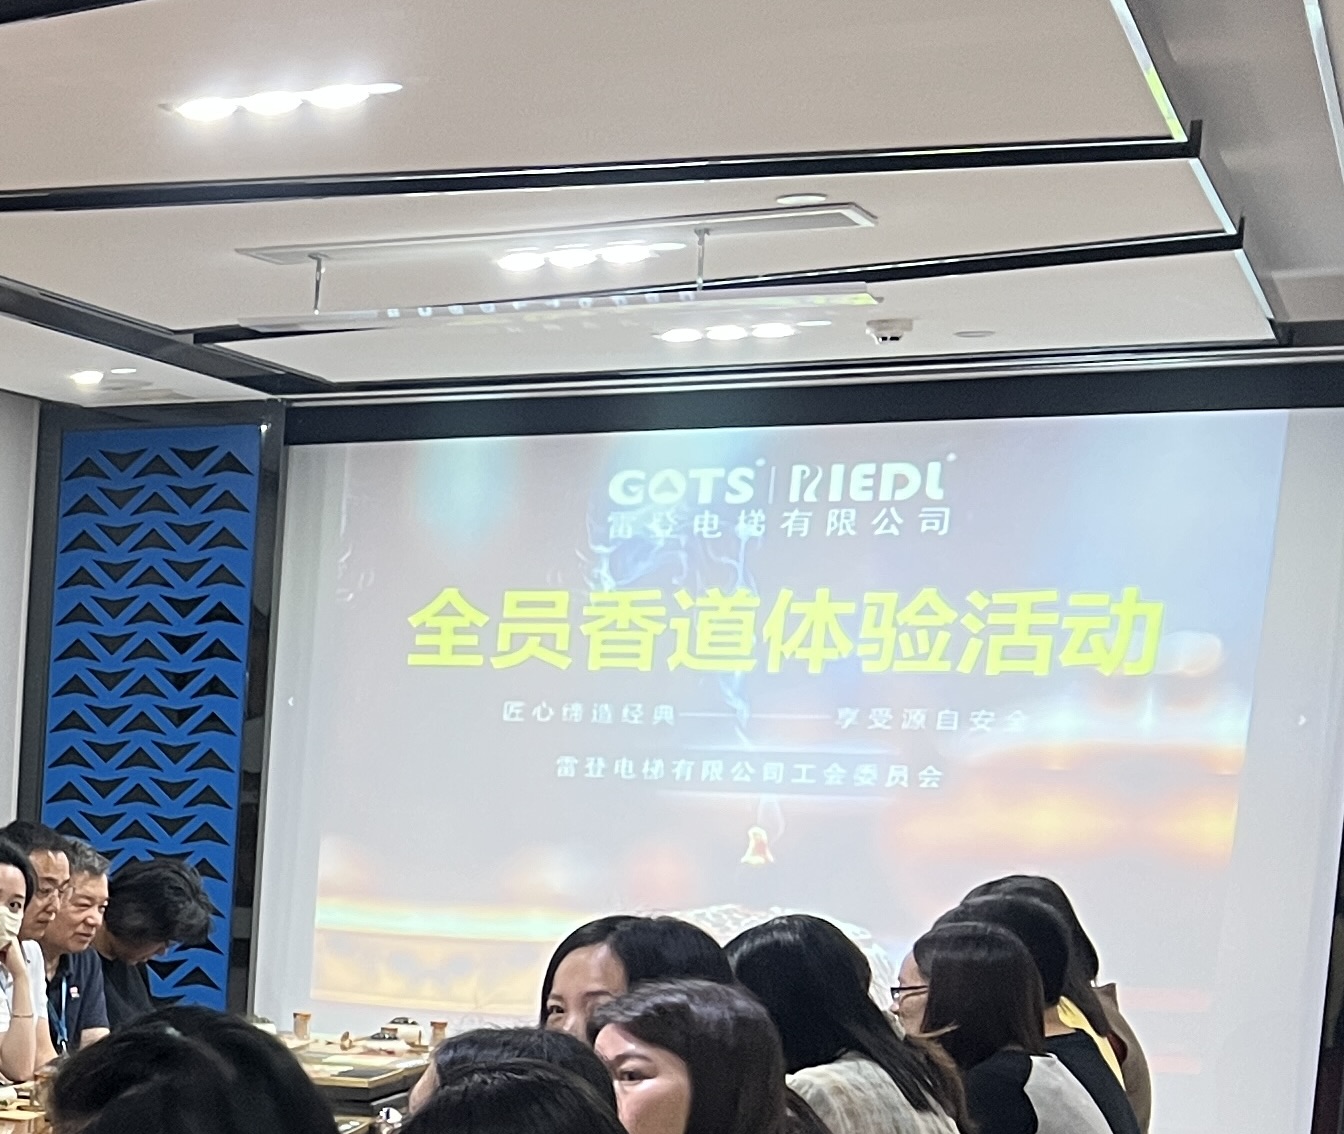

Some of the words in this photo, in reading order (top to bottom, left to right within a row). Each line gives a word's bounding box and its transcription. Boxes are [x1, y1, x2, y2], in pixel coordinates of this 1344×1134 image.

[608, 466, 755, 506] GOTS
[607, 506, 951, 540] 雷登电梯有限公司
[406, 586, 1164, 677] 全员香道体验活动
[555, 755, 945, 790] 雷登电梯有限公司工会委员会
